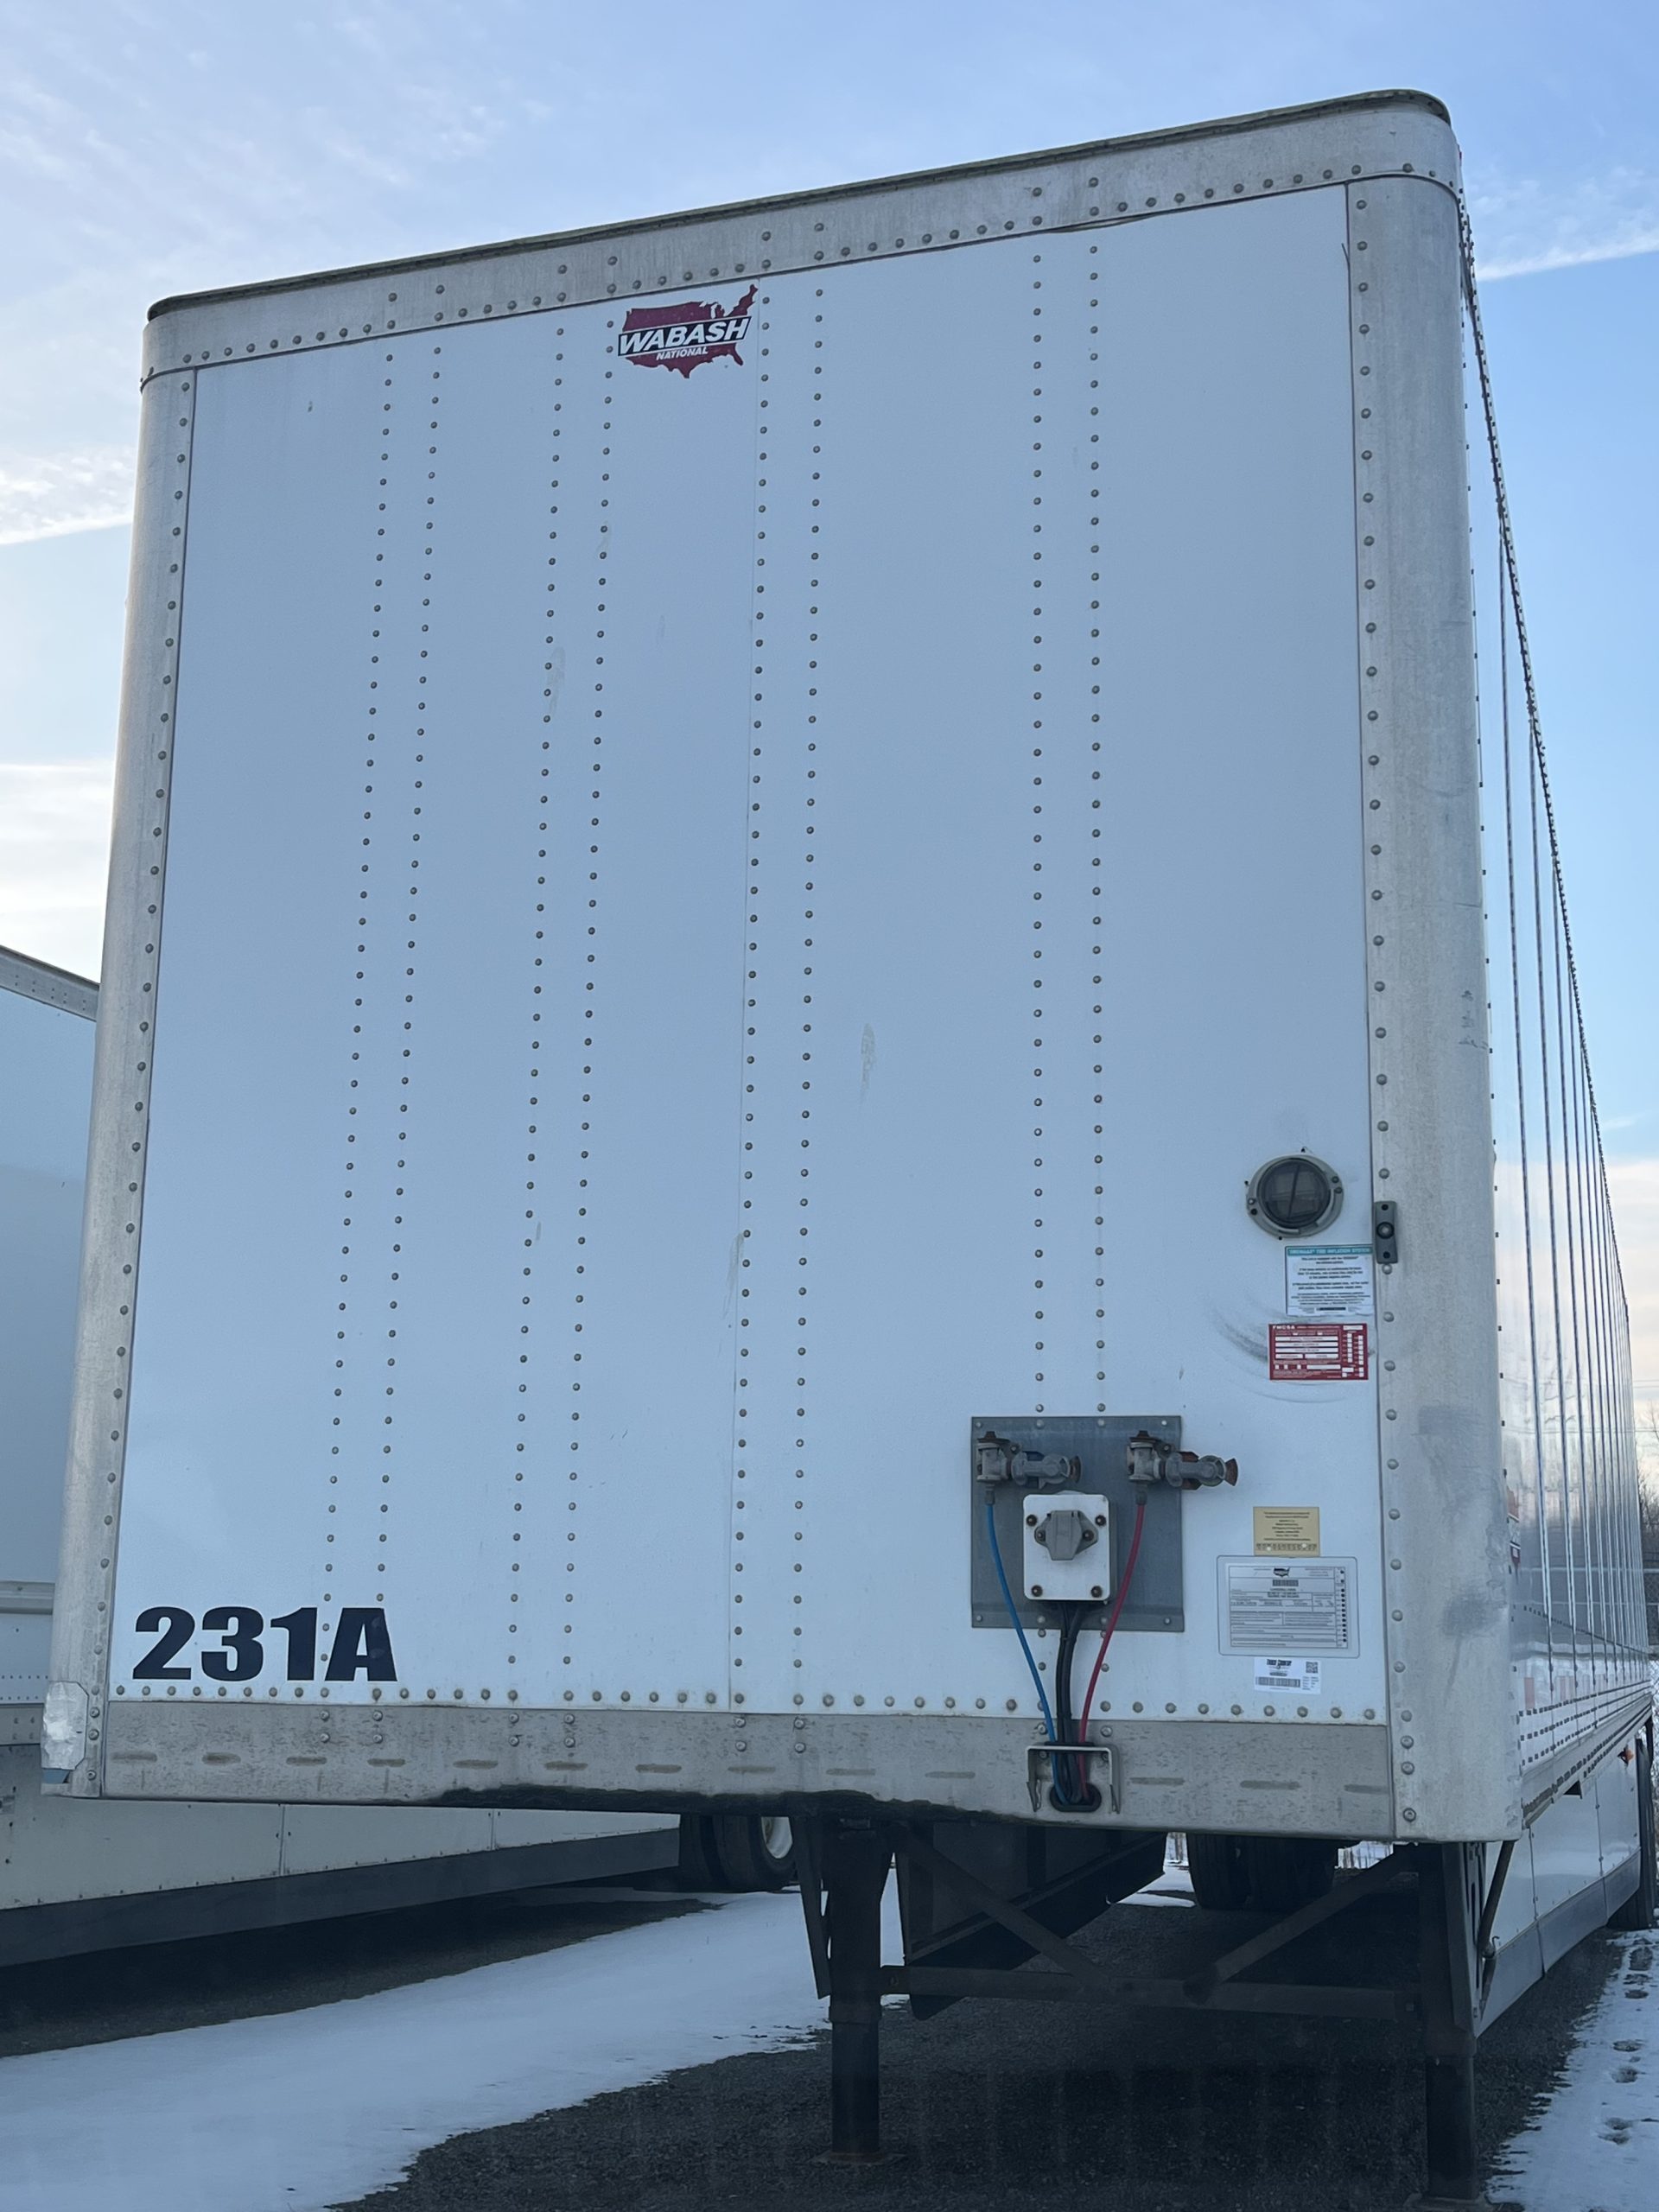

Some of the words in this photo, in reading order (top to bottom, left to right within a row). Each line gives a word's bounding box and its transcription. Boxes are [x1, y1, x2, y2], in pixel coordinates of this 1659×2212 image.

[620, 318, 749, 355] WABASH
[657, 346, 709, 360] NATIONAL
[133, 1606, 398, 1682] 231A
